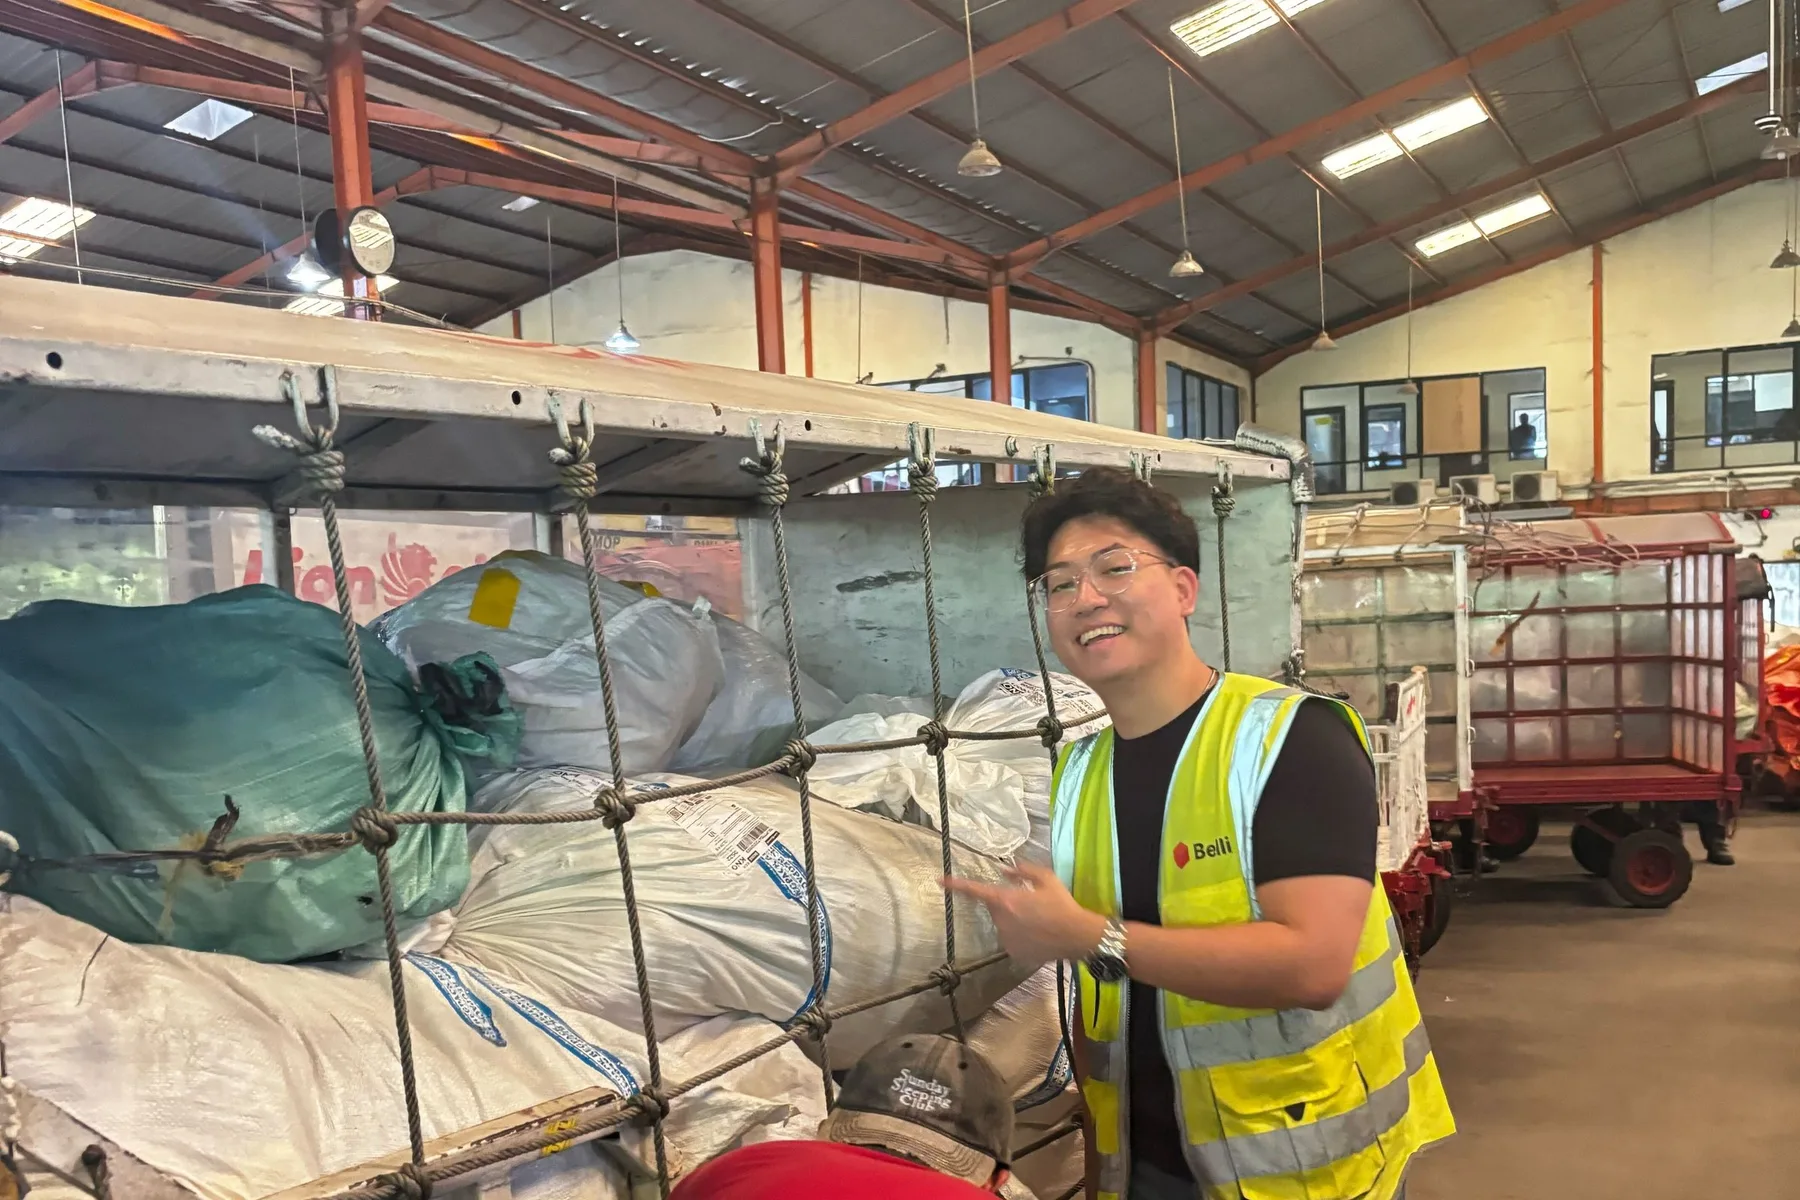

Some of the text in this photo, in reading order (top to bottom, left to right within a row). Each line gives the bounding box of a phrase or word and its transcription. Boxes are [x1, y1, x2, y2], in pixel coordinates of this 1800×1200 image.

[1193, 836, 1232, 860] Belli
[891, 1077, 952, 1109] Sleeping
[900, 1068, 951, 1097] Sunday
[899, 1094, 936, 1111] Club
